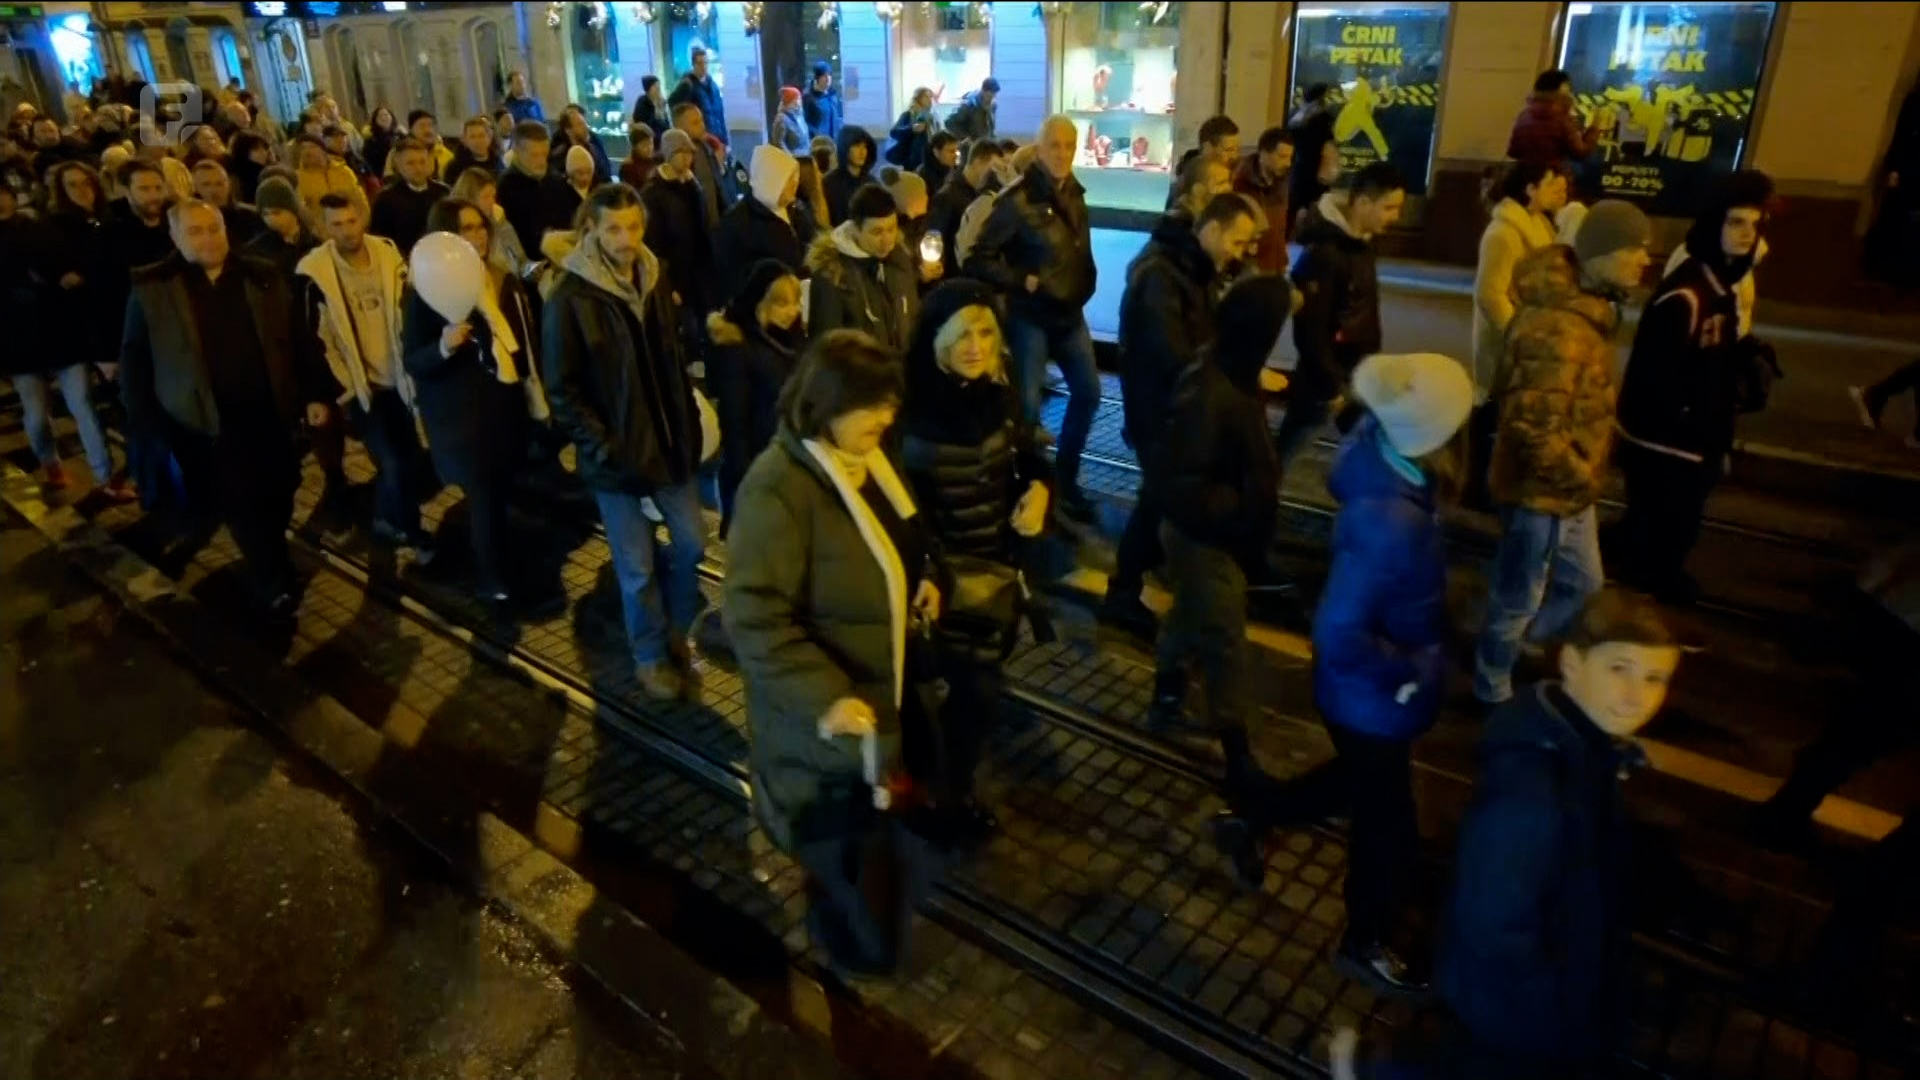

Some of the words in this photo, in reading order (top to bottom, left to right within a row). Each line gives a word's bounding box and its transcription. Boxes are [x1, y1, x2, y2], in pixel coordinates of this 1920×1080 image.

[1342, 25, 1396, 44] CRNI
[1330, 47, 1403, 65] PETAK
[1602, 175, 1623, 186] DO
